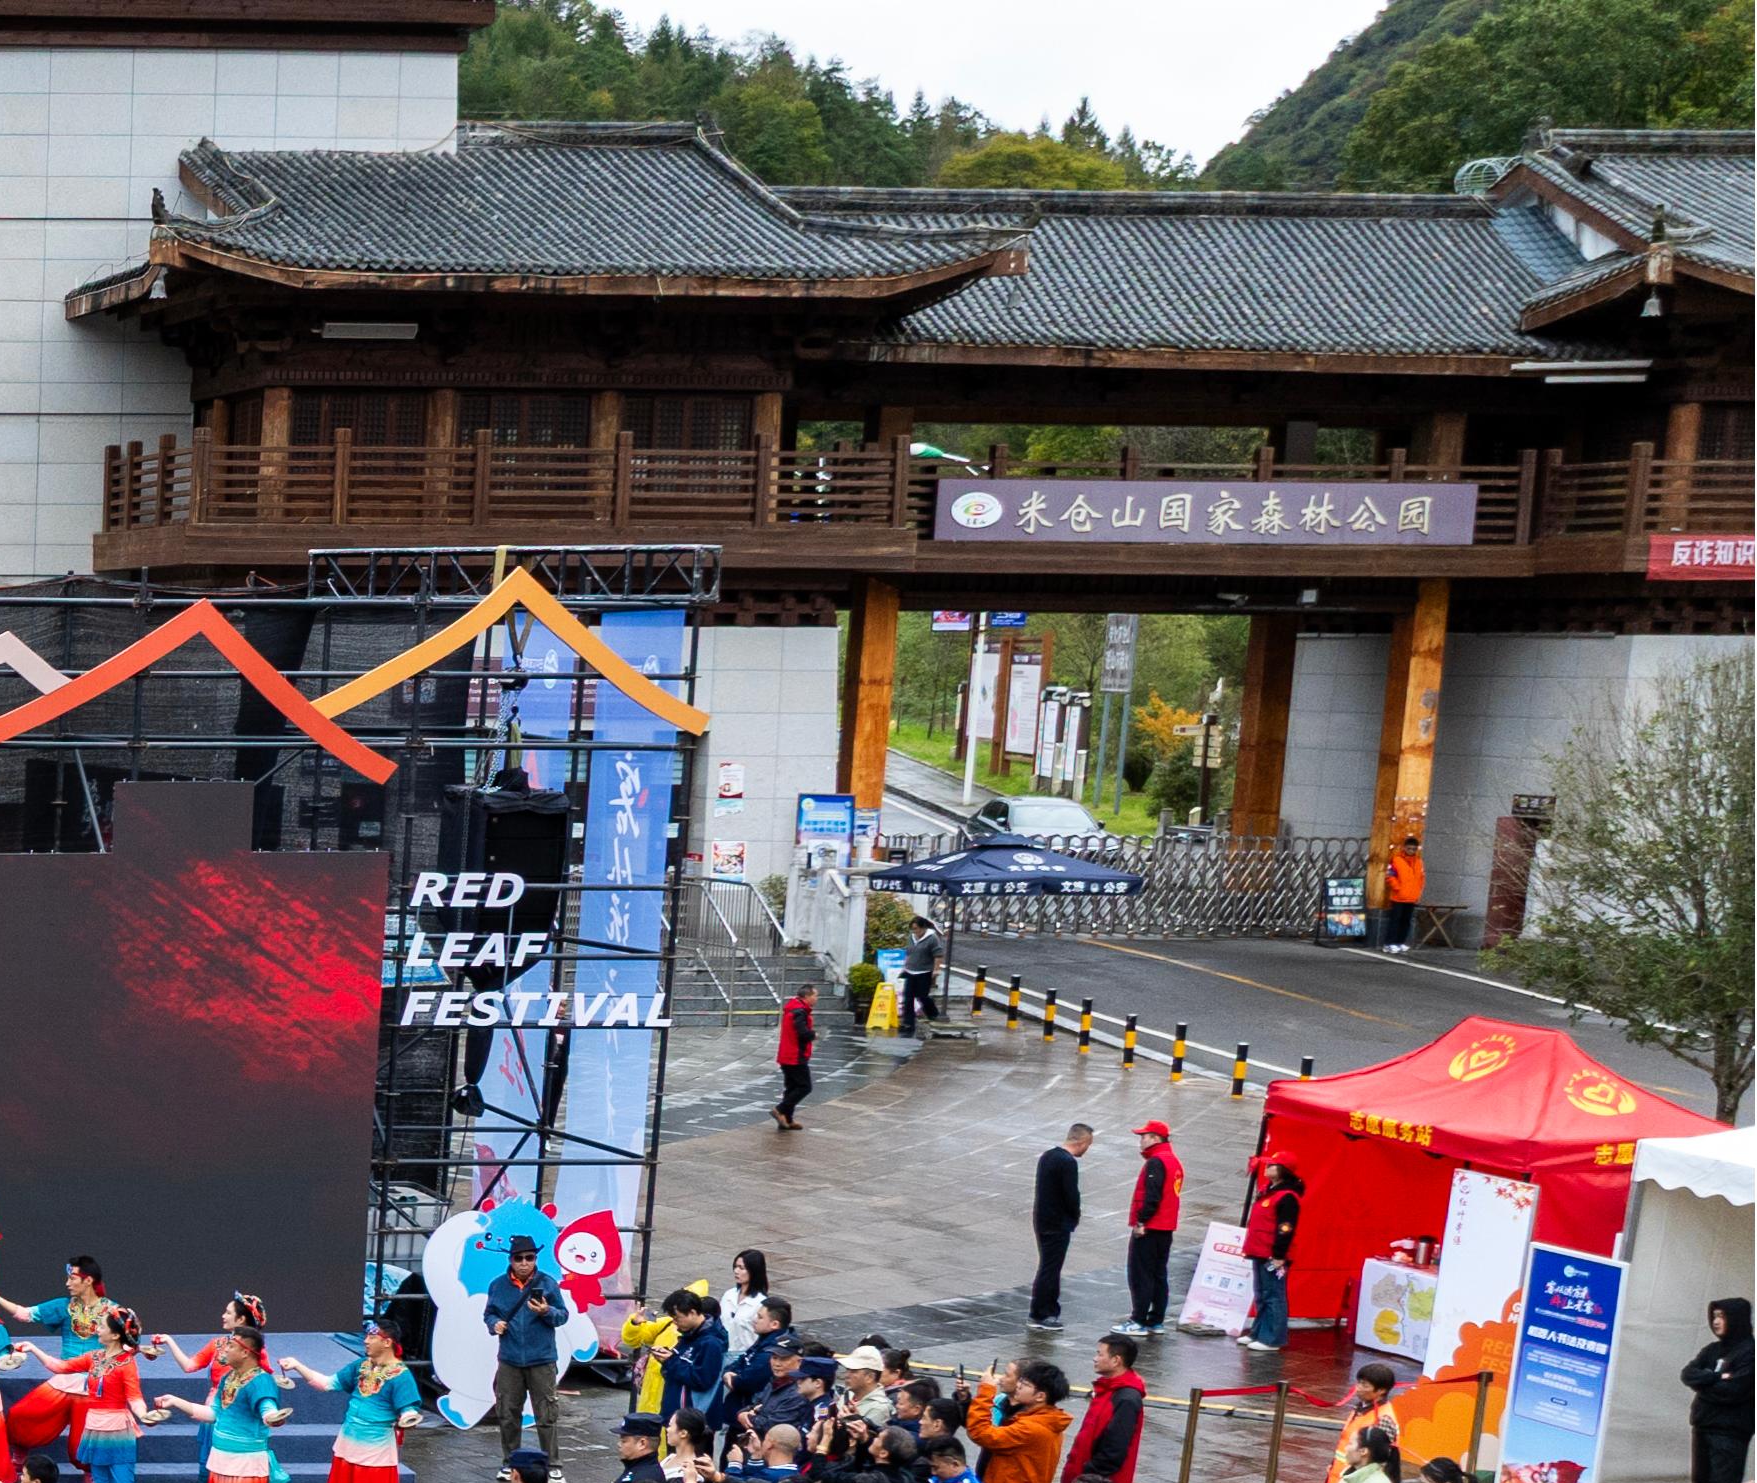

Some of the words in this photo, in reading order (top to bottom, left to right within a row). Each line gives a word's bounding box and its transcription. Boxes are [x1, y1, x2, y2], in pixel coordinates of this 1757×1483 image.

[1014, 490, 1434, 535] 米仓山国家森林公园
[1672, 541, 1756, 568] 反诈知识
[410, 872, 525, 908] RED
[405, 932, 548, 967] LEAF
[400, 993, 673, 1028] FESTIVAL
[1349, 1111, 1433, 1147] 志愿服务站
